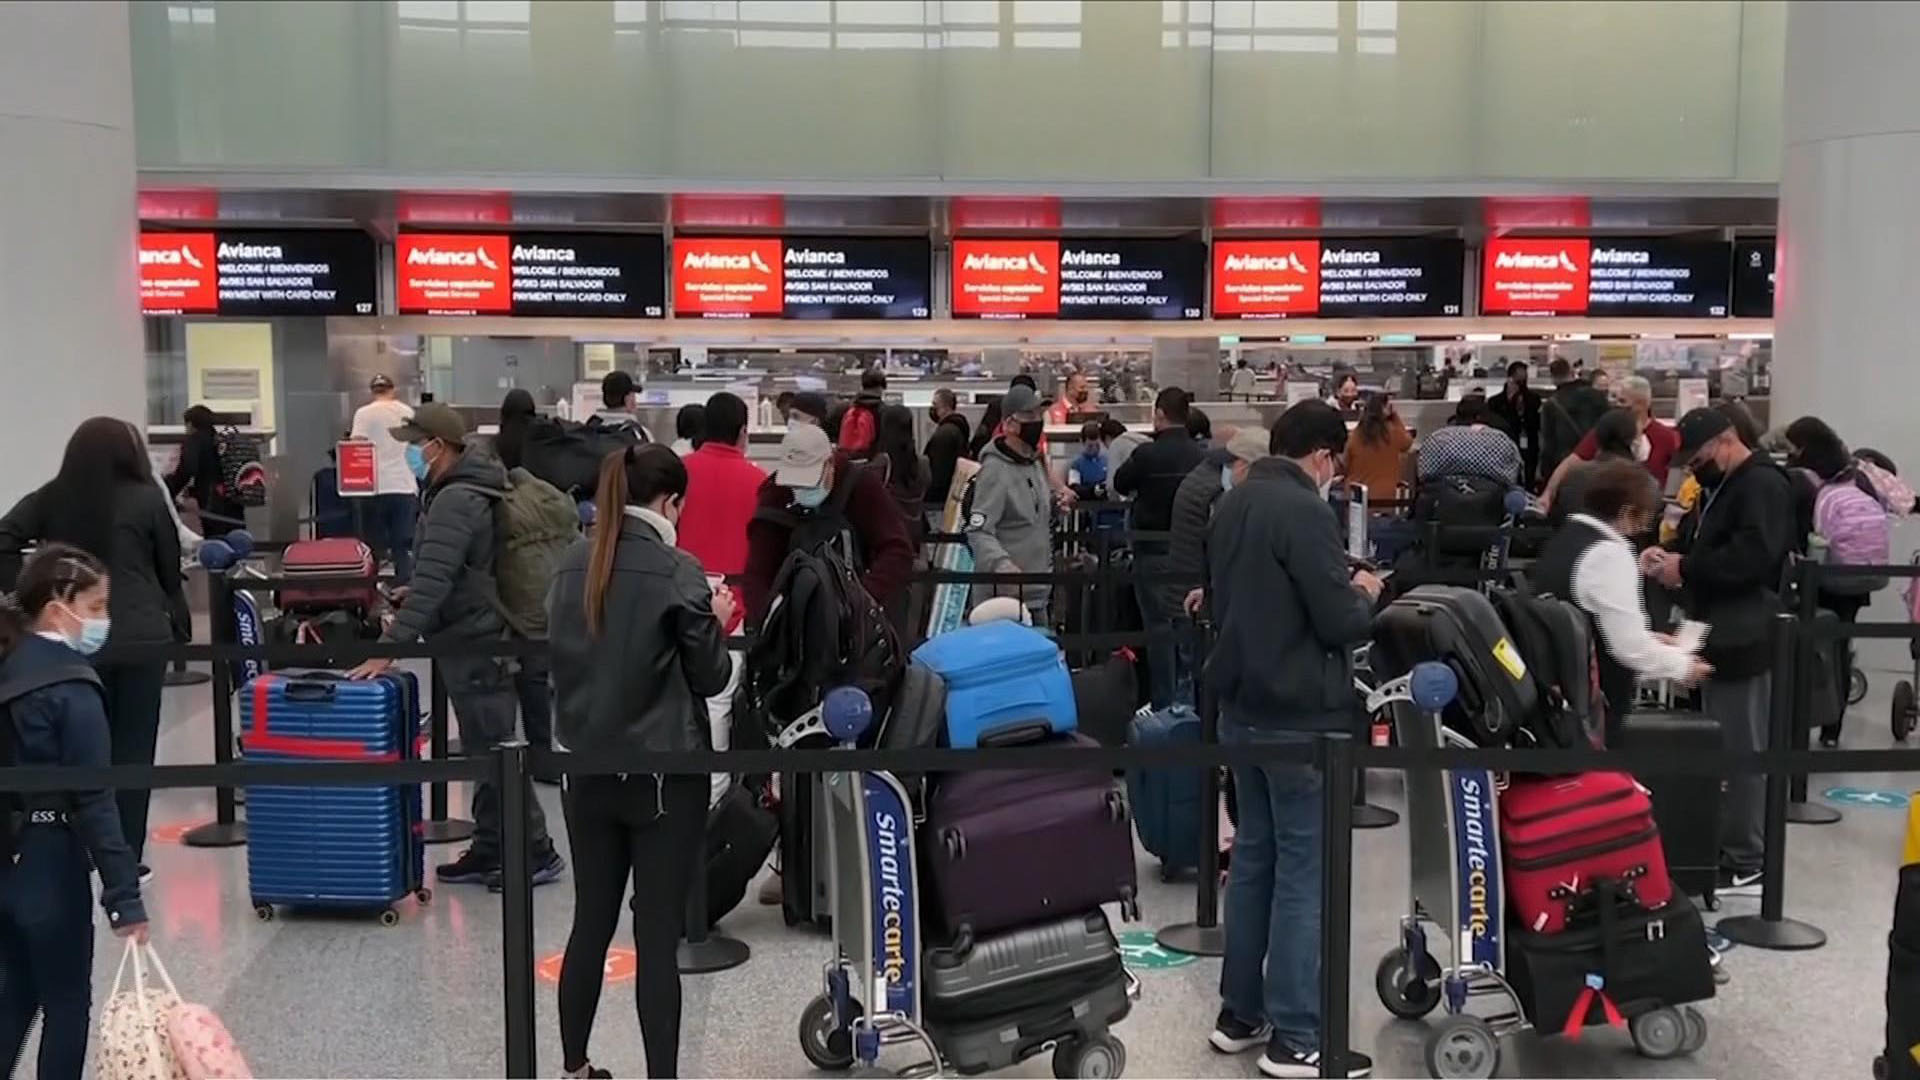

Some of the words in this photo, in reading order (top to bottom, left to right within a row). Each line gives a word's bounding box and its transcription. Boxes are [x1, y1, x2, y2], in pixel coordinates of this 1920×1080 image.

[217, 242, 282, 258] Avianca
[512, 245, 575, 261] Avianca
[139, 249, 181, 264] anca
[407, 247, 476, 265] Avianca
[684, 252, 750, 269] Avianca
[784, 248, 845, 264] Avianca
[1061, 250, 1120, 265] Avianca
[1321, 249, 1379, 264] Avianca
[1495, 252, 1558, 269] Avianca
[1591, 248, 1649, 264] Avianca
[963, 253, 1028, 270] Avianca
[1224, 254, 1288, 270] Avianca
[217, 264, 263, 273] WELCOME
[270, 264, 329, 273] BIENVENIDOS
[512, 266, 557, 276] WELCOME
[563, 266, 620, 276] BIENVENIDOS
[784, 269, 827, 278] WELCOME
[833, 269, 888, 278] BIENVENIDOS
[1321, 268, 1362, 278] WELCOME
[1368, 268, 1421, 278] BIENVENIDOS
[1590, 268, 1630, 278] WELCOME
[1061, 270, 1102, 279] WELCOME
[1108, 270, 1162, 279] BIENVENIDOS
[246, 277, 265, 286] SAN
[266, 277, 313, 286] SALVADOR
[540, 279, 558, 289] SAN
[559, 279, 604, 289] SALVADOR
[811, 282, 828, 291] SAN
[830, 282, 872, 291] SALVADOR
[1346, 281, 1363, 291] SAN
[1364, 281, 1406, 291] SALVADOR
[1614, 281, 1631, 290] SAN
[1086, 283, 1103, 292] SAN
[1105, 283, 1146, 292] SALVADOR
[219, 290, 260, 299] PAYMENT
[261, 290, 285, 299] WITH
[286, 290, 311, 299] CARD
[312, 290, 336, 299] ONLY
[512, 292, 553, 302] PAYMENT
[554, 292, 576, 302] WITH
[578, 292, 602, 302] CARD
[604, 292, 627, 302] ONLY
[785, 295, 823, 304] PAYMENT
[825, 295, 847, 304] WITH
[848, 295, 871, 304] CARD
[872, 295, 894, 304] ONLY
[1320, 293, 1360, 303] PAYMENT
[1360, 293, 1380, 303] WITH
[1382, 293, 1404, 303] CARD
[1405, 293, 1427, 303] ONLY
[1649, 293, 1671, 302] CARD
[1672, 293, 1694, 302] ONLY
[1061, 296, 1099, 304] PAYMENT
[1100, 296, 1121, 304] WITH
[1122, 296, 1145, 304] CARD
[1146, 296, 1168, 304] ONLY
[356, 303, 372, 313] 127
[645, 306, 661, 315] 128
[912, 307, 928, 316] 129
[1185, 308, 1200, 317] 130
[1444, 305, 1459, 314] 131
